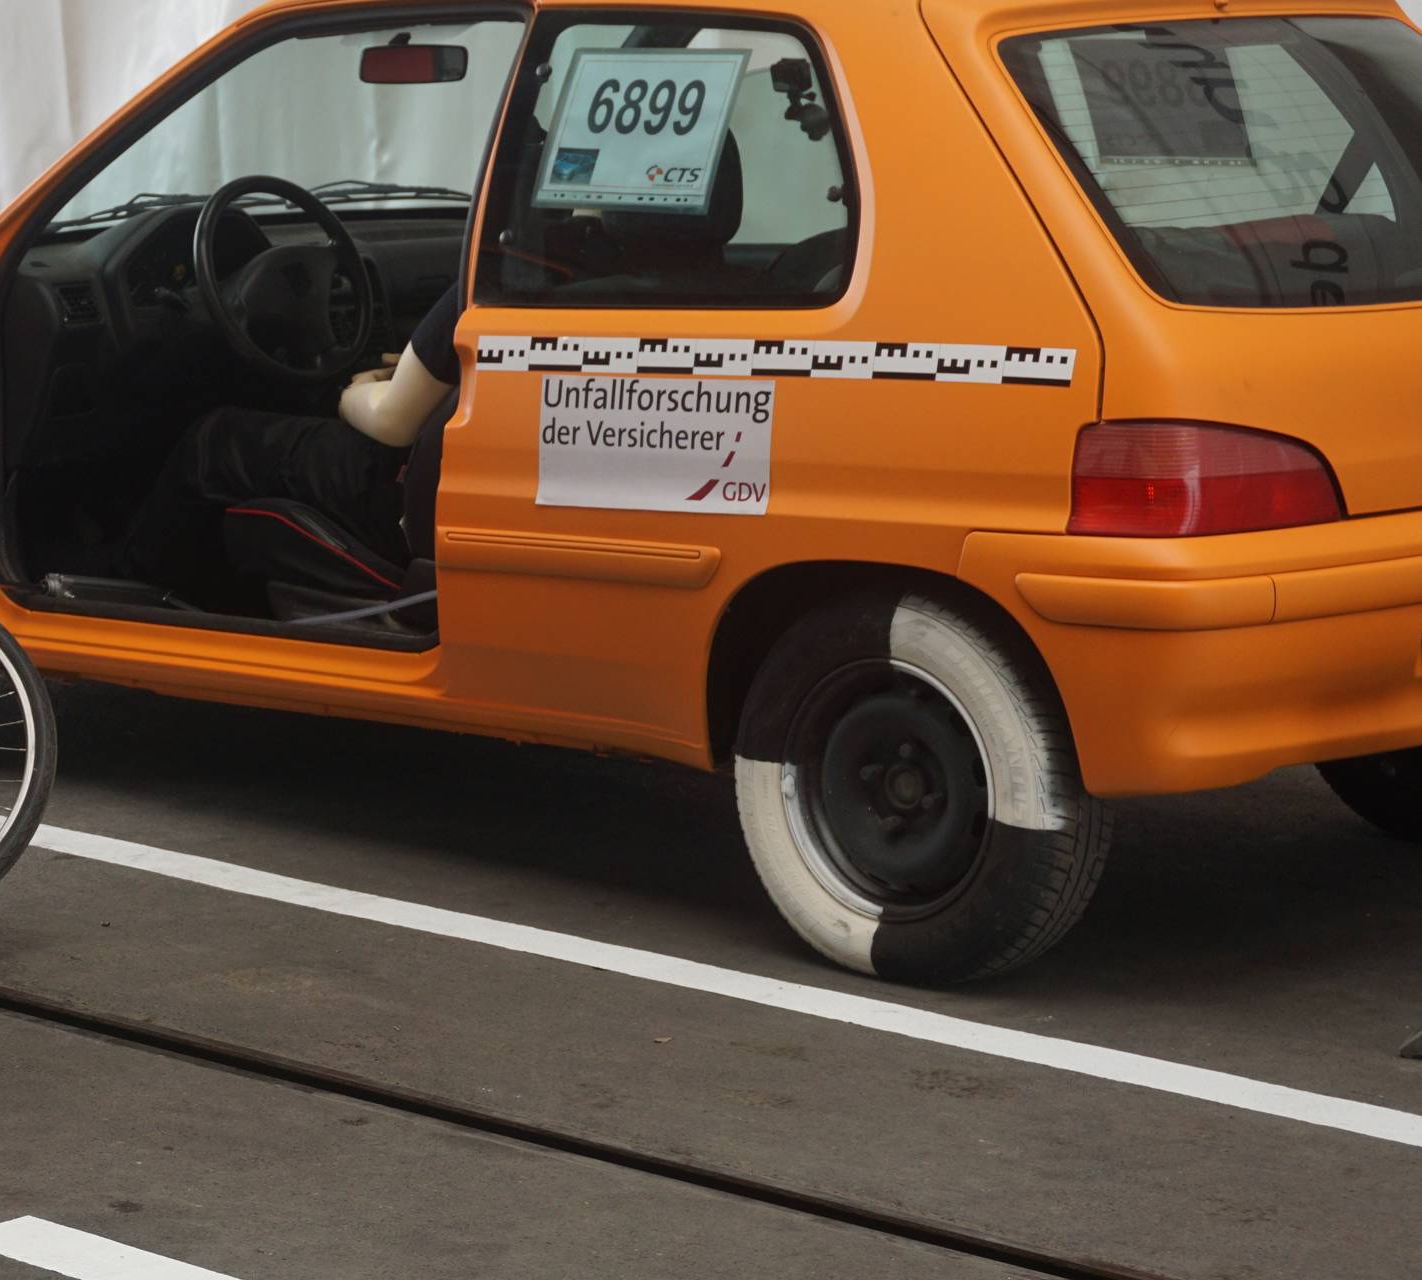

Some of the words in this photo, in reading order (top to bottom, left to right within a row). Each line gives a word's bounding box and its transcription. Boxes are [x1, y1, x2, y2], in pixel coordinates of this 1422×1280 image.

[587, 78, 706, 136] 6899
[664, 167, 701, 183] CTS
[544, 378, 771, 424] Unfallforschung
[542, 416, 580, 445] der
[586, 419, 725, 451] Versicherer
[722, 481, 766, 503] GDV
